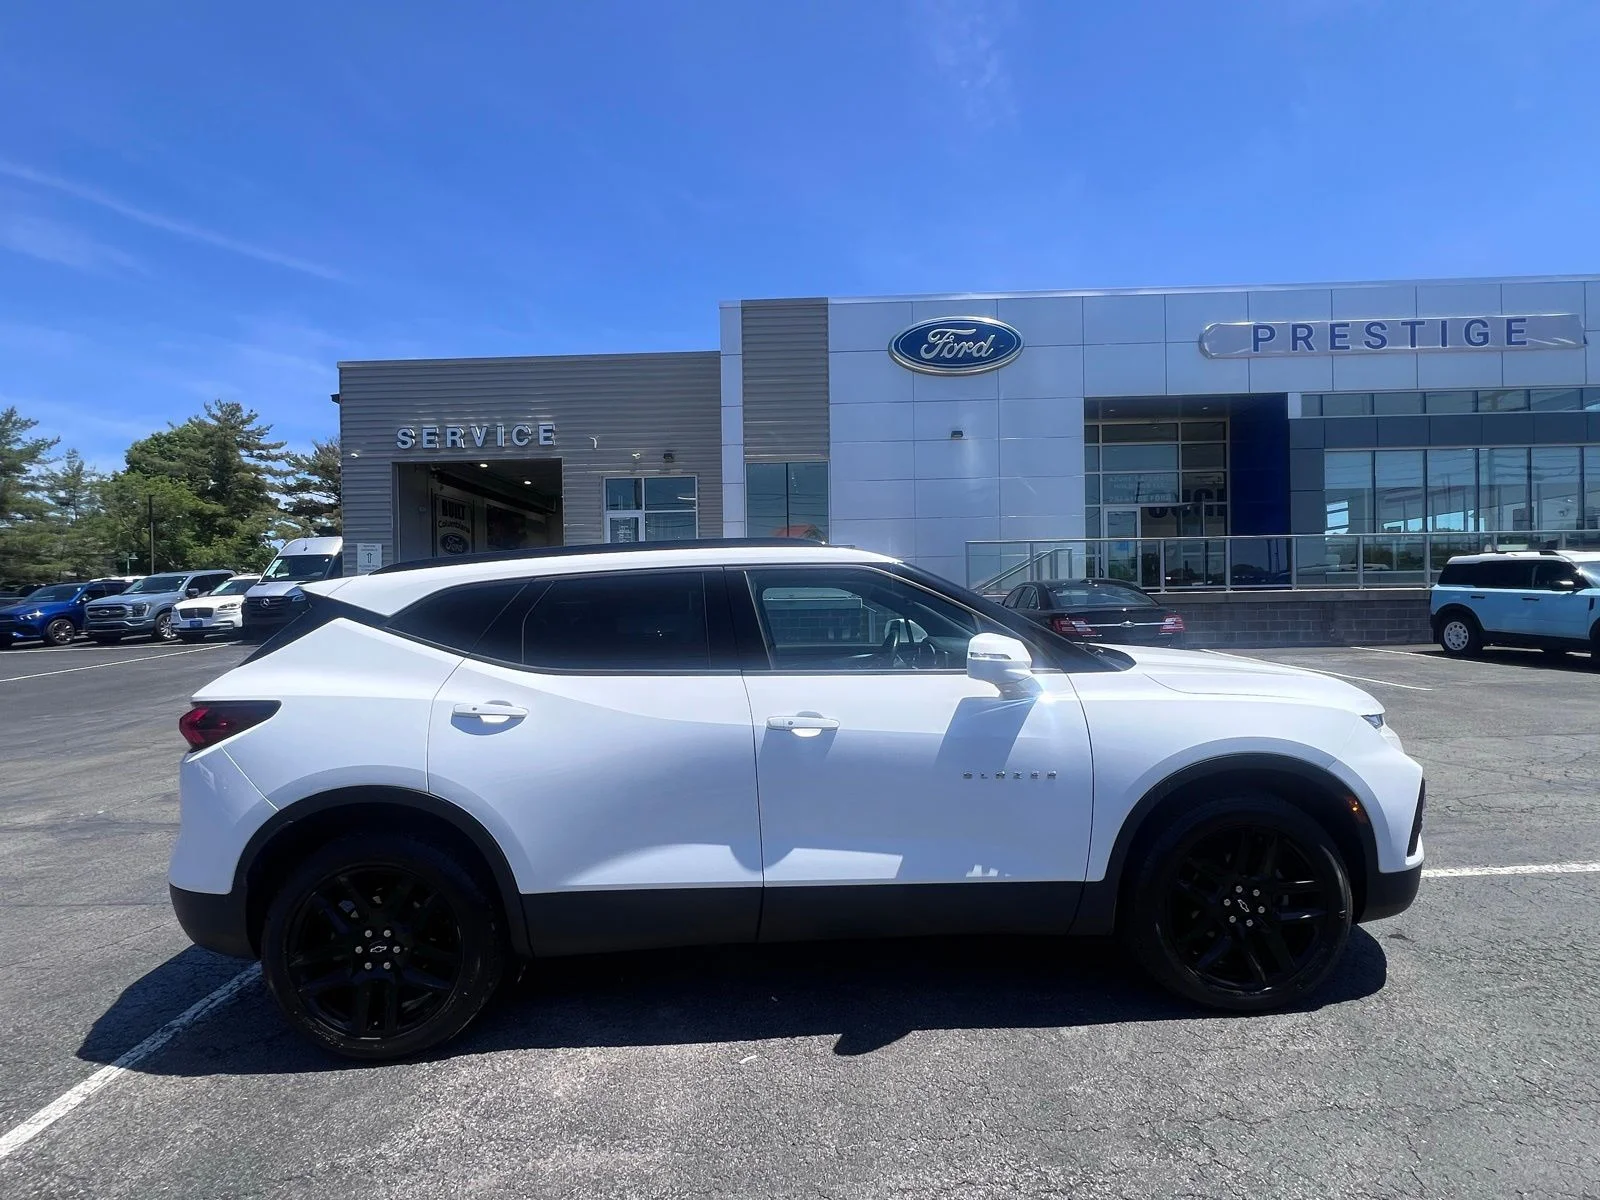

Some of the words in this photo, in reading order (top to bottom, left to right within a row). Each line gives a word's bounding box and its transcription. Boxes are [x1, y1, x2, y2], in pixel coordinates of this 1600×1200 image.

[920, 328, 996, 359] Ford
[1251, 317, 1528, 353] PRESTIGE
[396, 423, 556, 449] SERVICE
